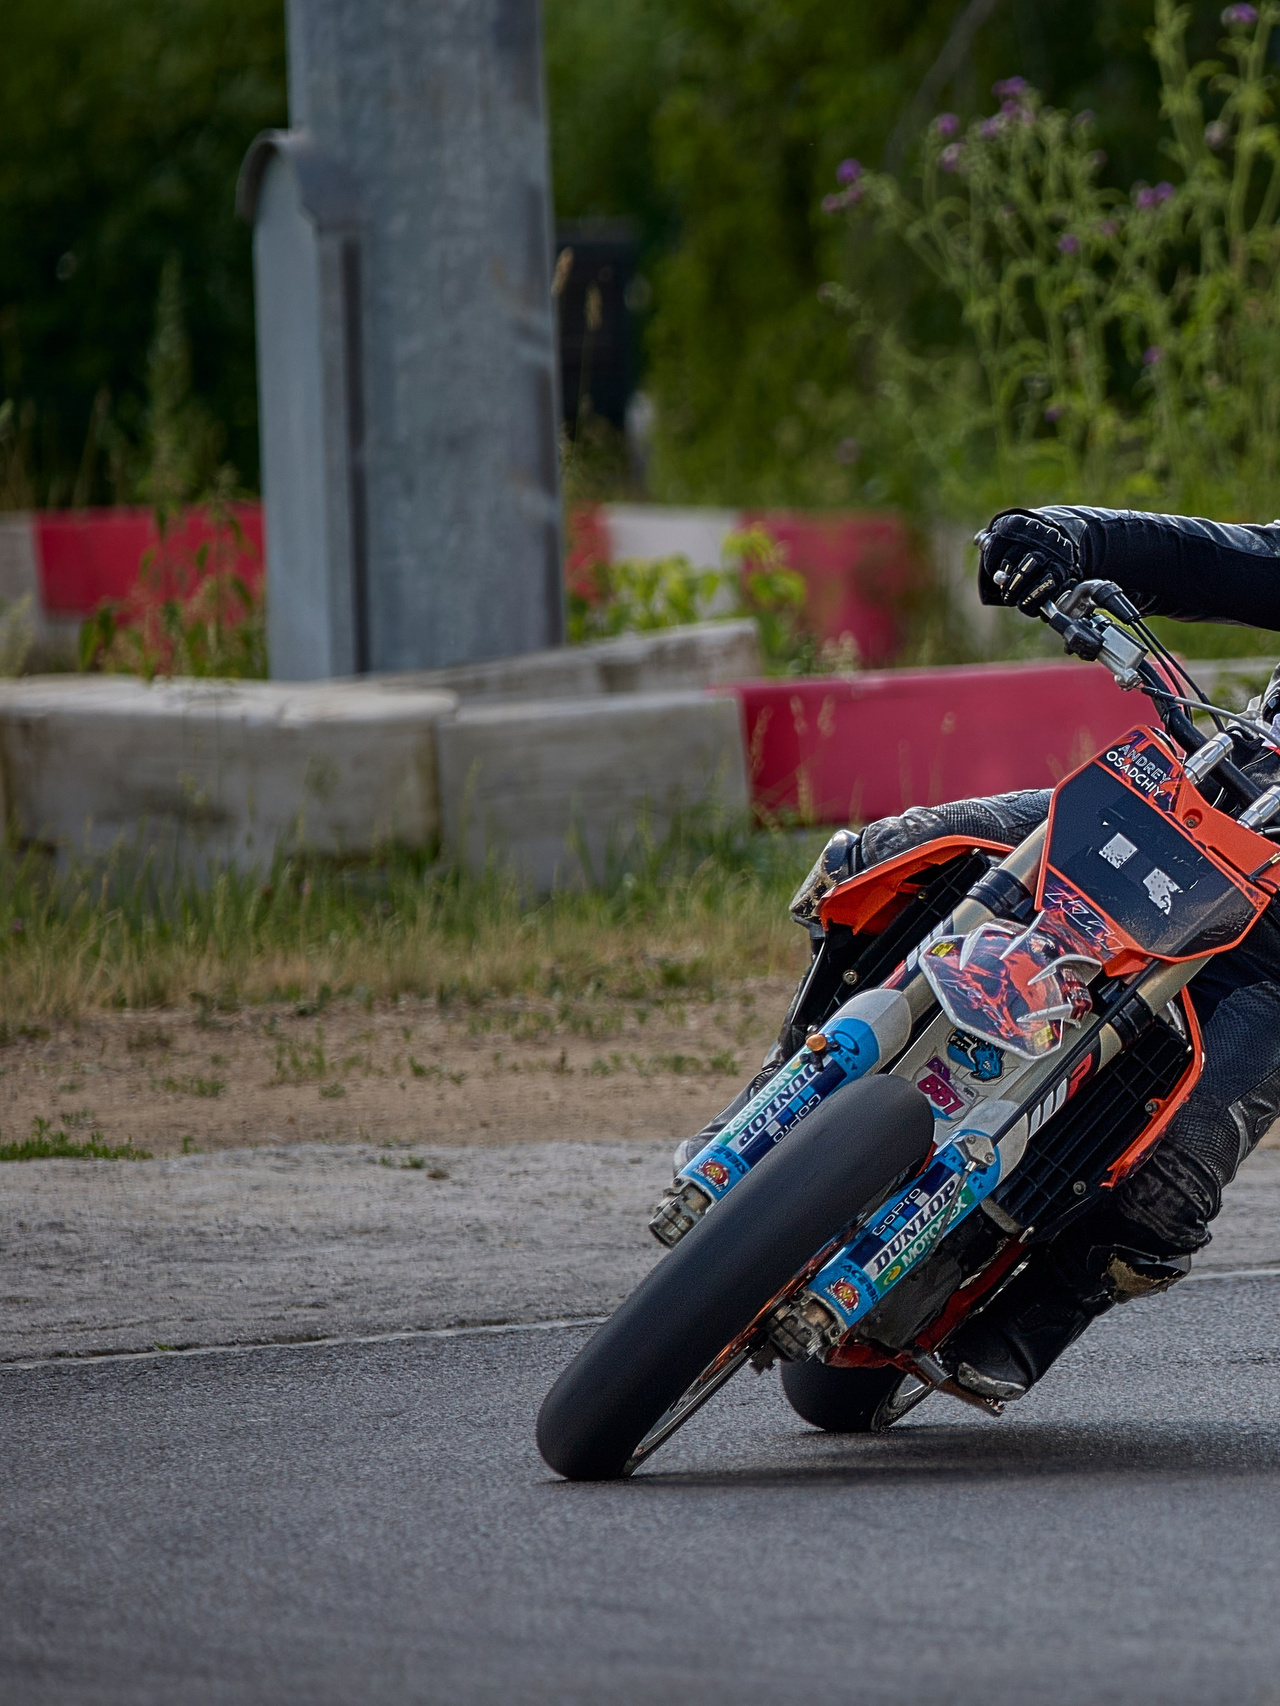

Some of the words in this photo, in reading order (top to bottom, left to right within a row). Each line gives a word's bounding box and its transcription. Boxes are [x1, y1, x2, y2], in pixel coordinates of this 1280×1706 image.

[1106, 751, 1164, 797] OSADCHIY
[1118, 744, 1171, 785] ANDREY
[1045, 893, 1124, 950] KTM
[722, 1071, 793, 1138] MOTOREX
[872, 1188, 922, 1237] GoPro
[872, 1178, 957, 1275] DUNLOP
